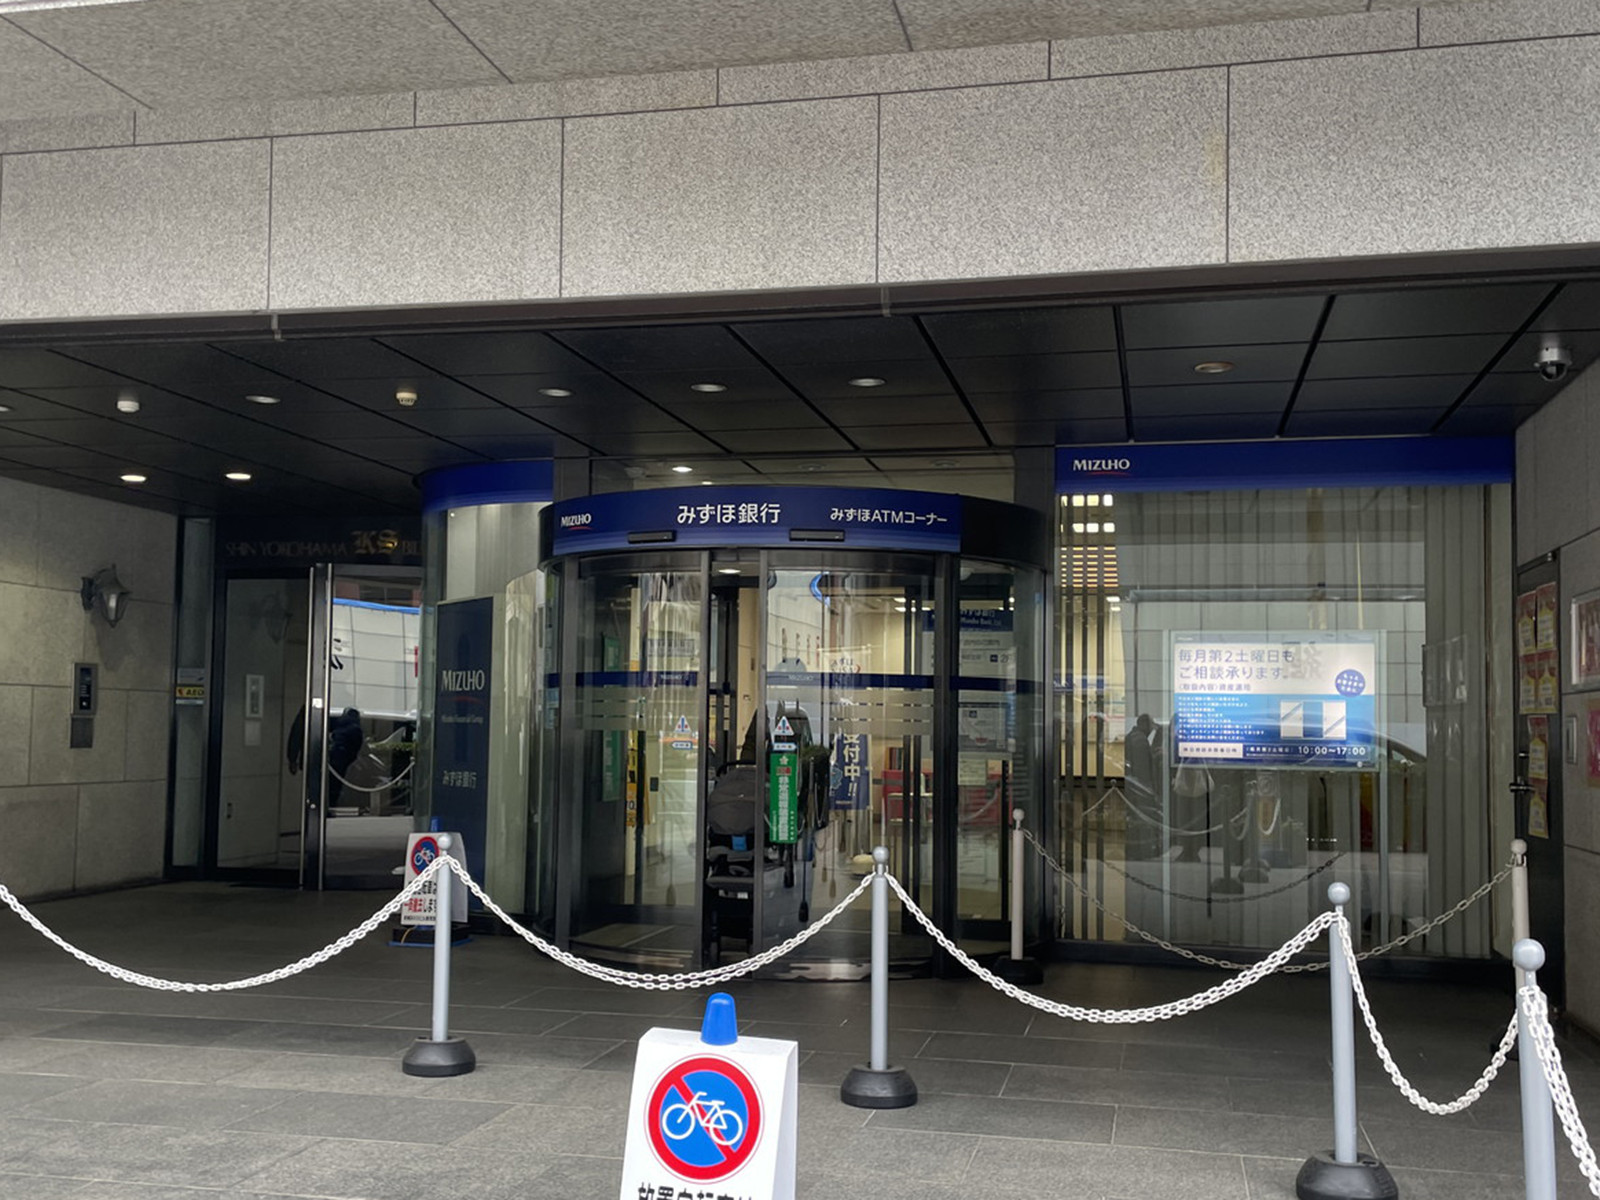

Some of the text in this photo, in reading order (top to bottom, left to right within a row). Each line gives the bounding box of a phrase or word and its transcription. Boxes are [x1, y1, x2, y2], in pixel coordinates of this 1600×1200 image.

[1073, 458, 1130, 471] MIZUHO
[560, 513, 592, 527] MIZUHO
[677, 503, 781, 524] みずほ銀行
[830, 508, 948, 525] みずほATMコーナー
[1178, 649, 1295, 663] 毎月第2土曜日も
[1179, 666, 1288, 679] ご相談承ります。
[441, 670, 485, 691] MIZUHO
